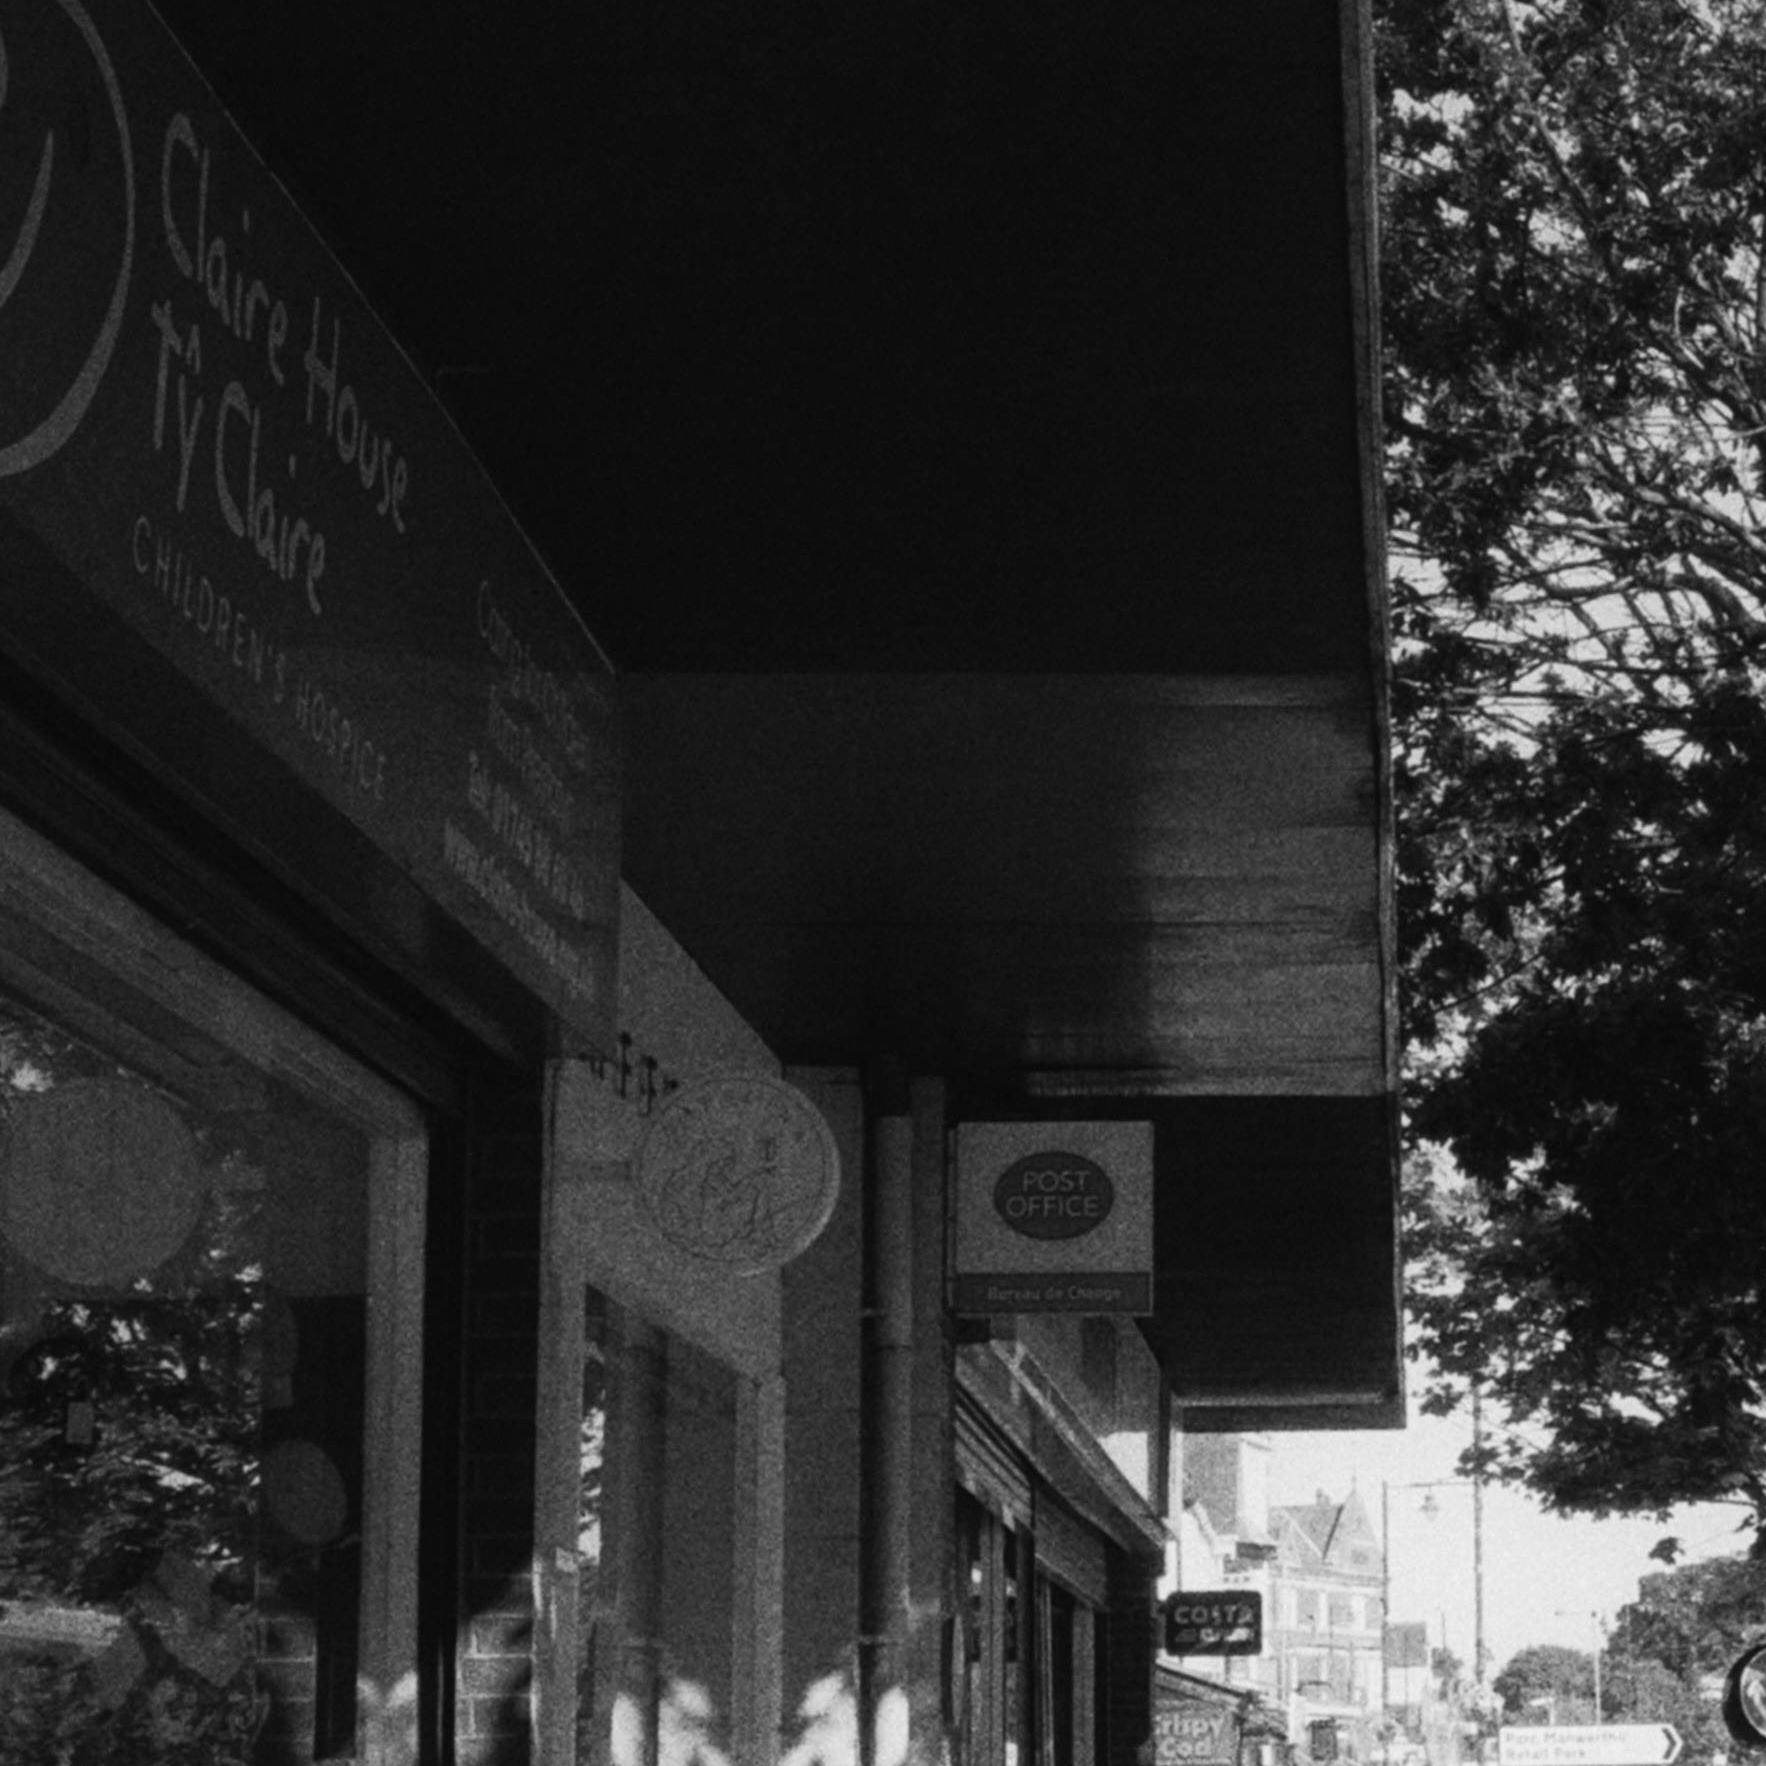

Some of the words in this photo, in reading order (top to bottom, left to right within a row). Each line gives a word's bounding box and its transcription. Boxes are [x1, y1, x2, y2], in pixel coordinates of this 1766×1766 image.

[160, 112, 288, 388] Claire
[303, 295, 407, 535] House
[215, 380, 326, 616] Claire
[132, 514, 287, 705] CHILDREN'S
[295, 679, 387, 804] HOSPICE
[1022, 1169, 1090, 1192] POST
[1005, 1194, 1100, 1218] OFFICE
[1044, 1285, 1063, 1301] de
[1067, 1285, 1121, 1303] Change
[1174, 1604, 1254, 1625] COSTA
[1155, 1712, 1225, 1738] rispy
[1161, 1736, 1212, 1758] Cod
